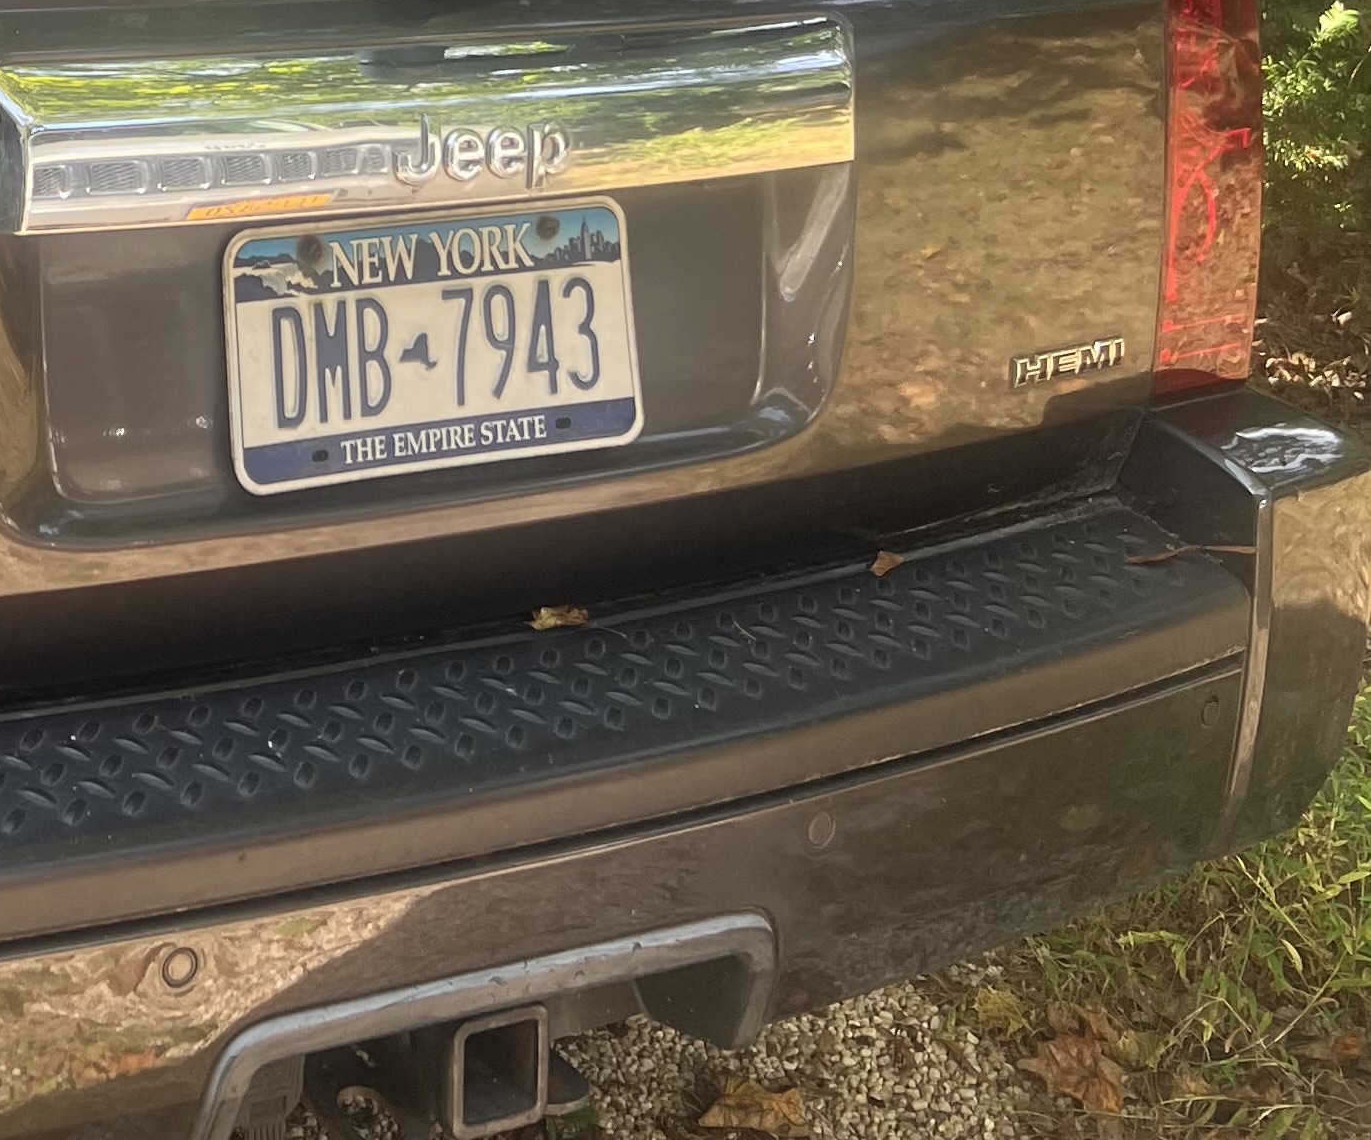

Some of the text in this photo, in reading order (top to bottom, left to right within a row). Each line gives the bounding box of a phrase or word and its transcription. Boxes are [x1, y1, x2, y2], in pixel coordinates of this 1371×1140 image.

[392, 112, 571, 190] Jeep
[327, 222, 535, 289] NEW YORK
[272, 276, 601, 430] DMB 7943
[1011, 337, 1125, 388] HEMI
[340, 415, 547, 465] THE EMPIRE STATE
